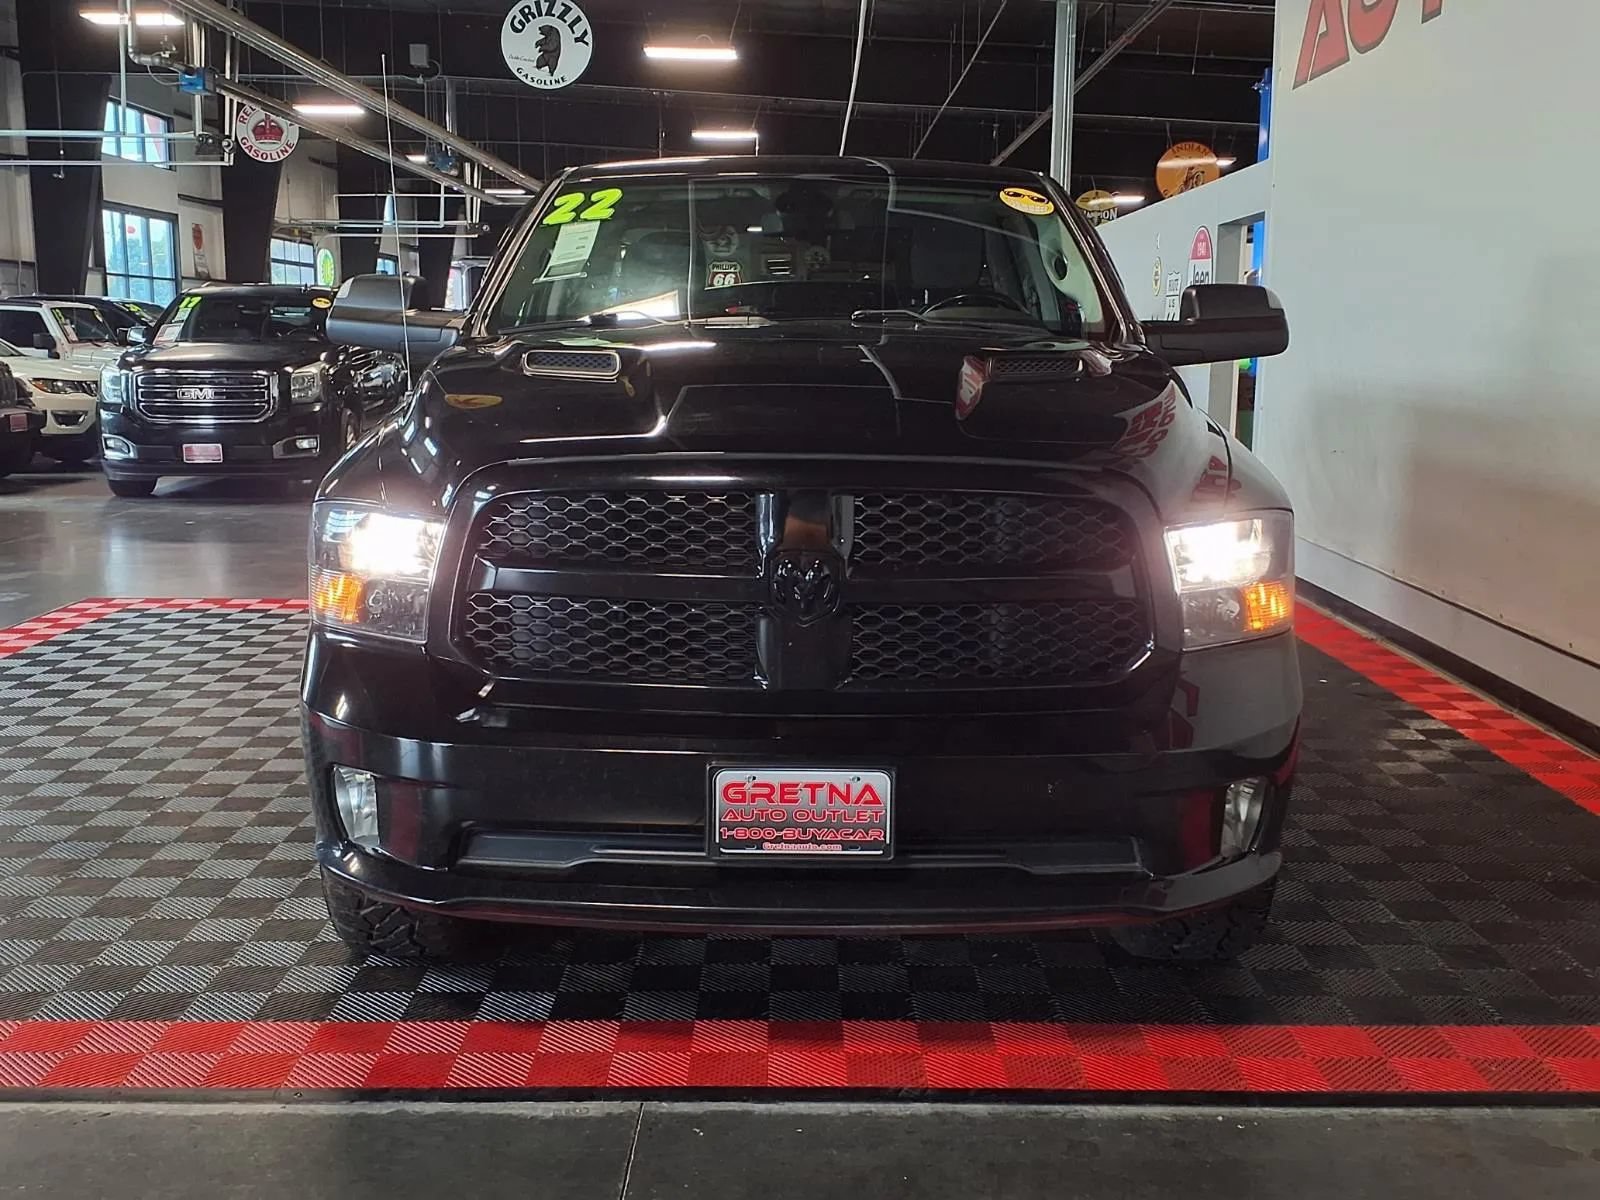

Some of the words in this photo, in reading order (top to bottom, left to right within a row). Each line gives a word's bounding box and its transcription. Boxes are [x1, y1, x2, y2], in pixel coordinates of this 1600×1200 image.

[510, 0, 589, 46] GRIZZLY
[516, 67, 567, 86] GASOLINE
[240, 136, 294, 160] GASOLINE
[1171, 143, 1210, 157] INDIAN
[542, 188, 623, 226] 22
[711, 262, 738, 271] PHILLIPS
[713, 273, 736, 287] 66
[176, 388, 226, 400] GMC
[722, 782, 884, 806] GRETNA
[721, 808, 787, 822] AUTO
[793, 809, 886, 823] OUTLET
[720, 827, 884, 841] 1-800-BUYACAR
